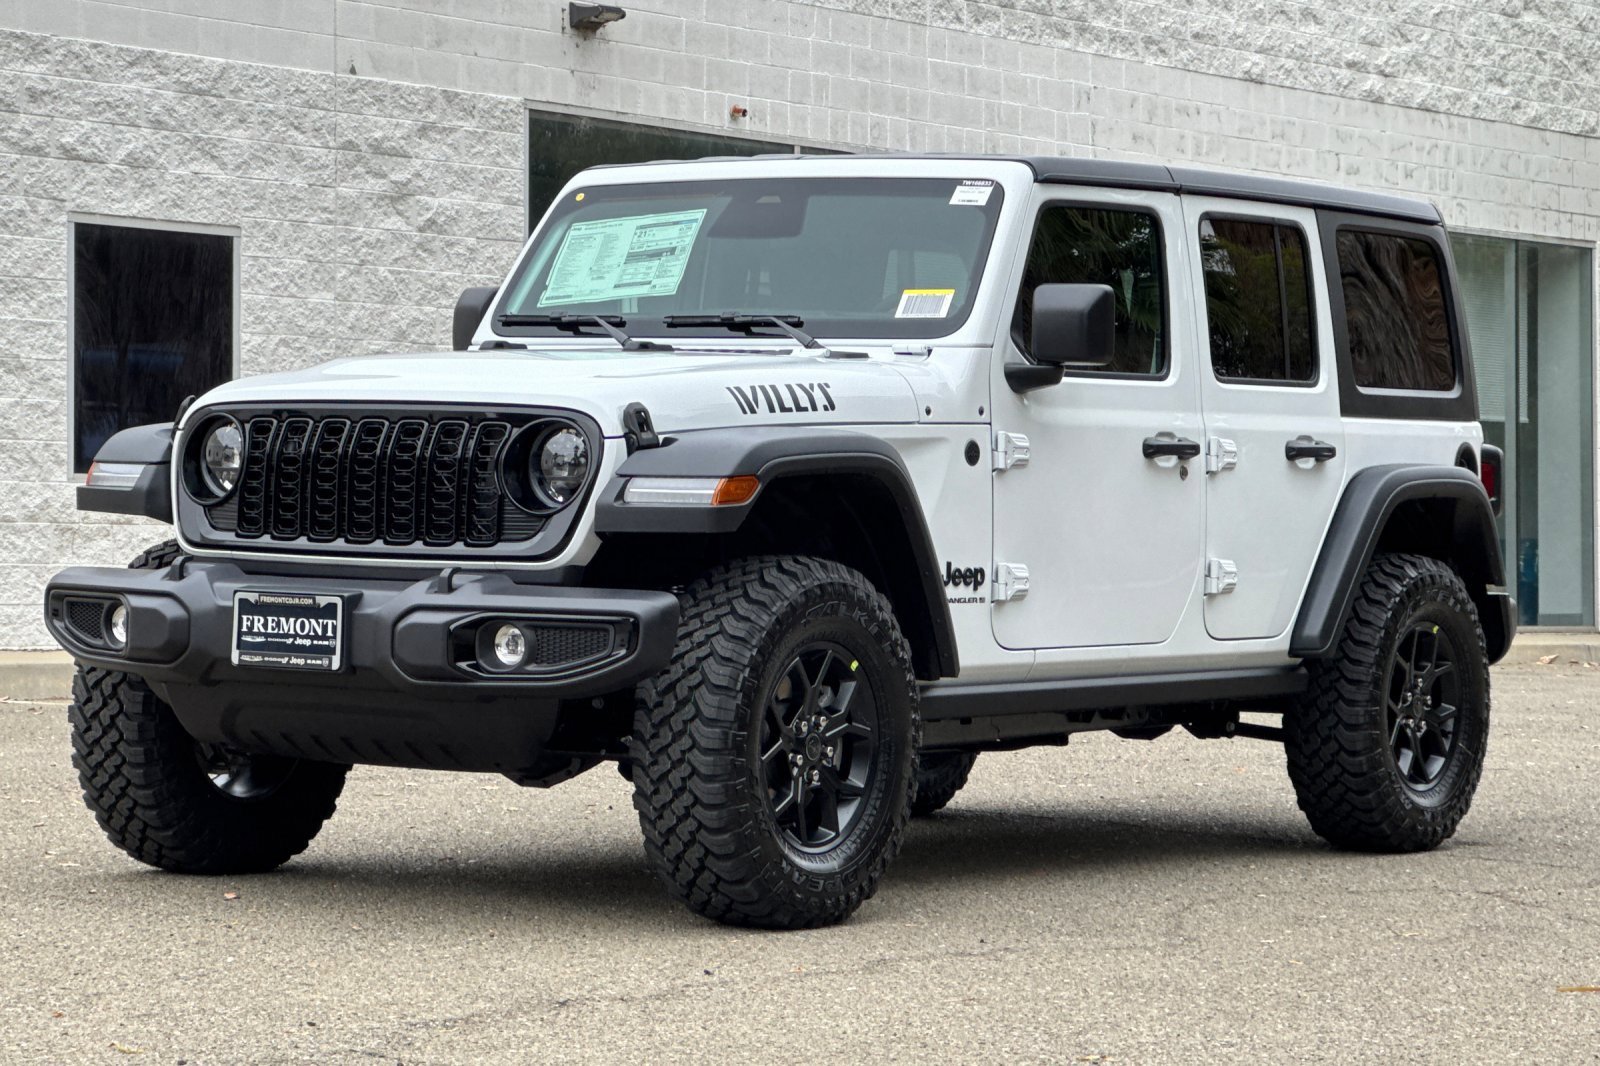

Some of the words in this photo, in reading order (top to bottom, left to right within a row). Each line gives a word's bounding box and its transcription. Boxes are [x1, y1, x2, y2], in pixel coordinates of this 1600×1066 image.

[725, 382, 836, 414] WILLYS
[942, 561, 986, 591] Jeep
[260, 595, 313, 605] FREMONTCDJR.COM
[241, 615, 337, 636] FREMONT
[294, 636, 312, 647] Jeep
[289, 656, 305, 666] Jeep
